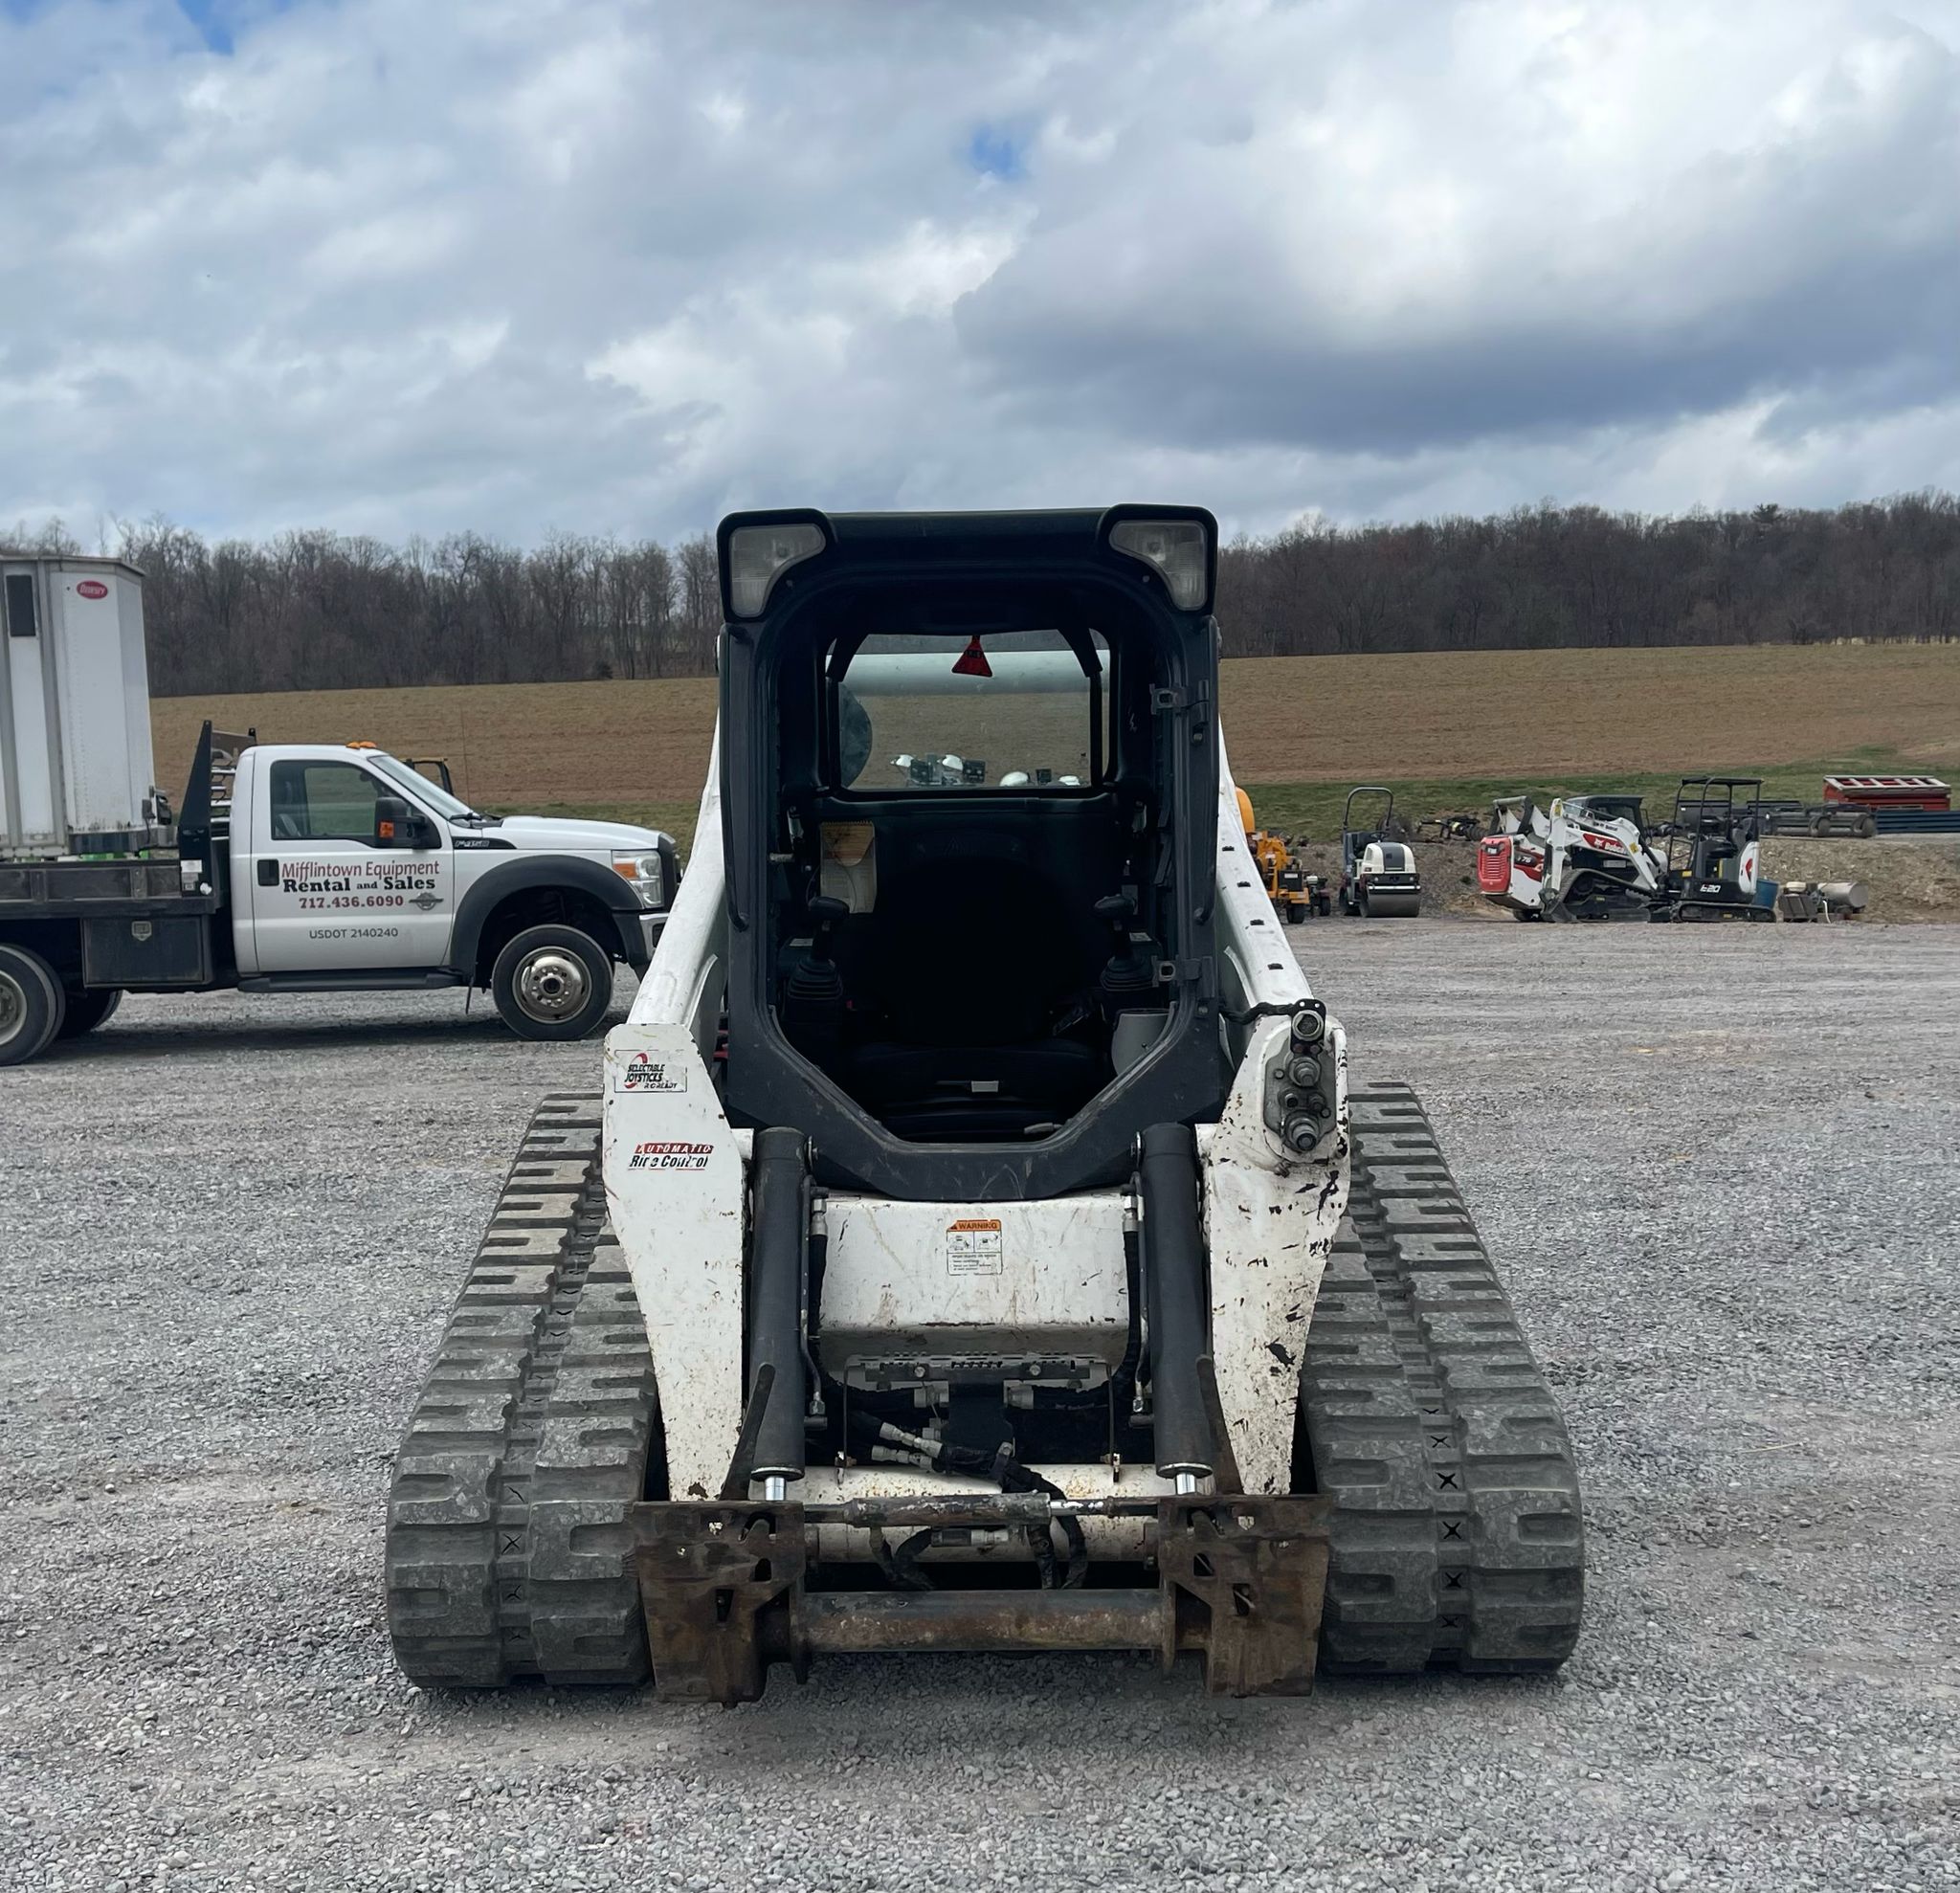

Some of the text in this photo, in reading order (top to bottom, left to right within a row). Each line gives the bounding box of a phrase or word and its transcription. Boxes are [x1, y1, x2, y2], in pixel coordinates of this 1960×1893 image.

[281, 859, 440, 881] Mifflintown Equipment
[283, 876, 435, 893] Rental and Sales
[299, 895, 404, 908] 717.436.6090
[309, 927, 399, 939] USDOT 2140240
[624, 1073, 663, 1082] JOYSTICKS
[637, 1144, 712, 1153] AUTOMATIC
